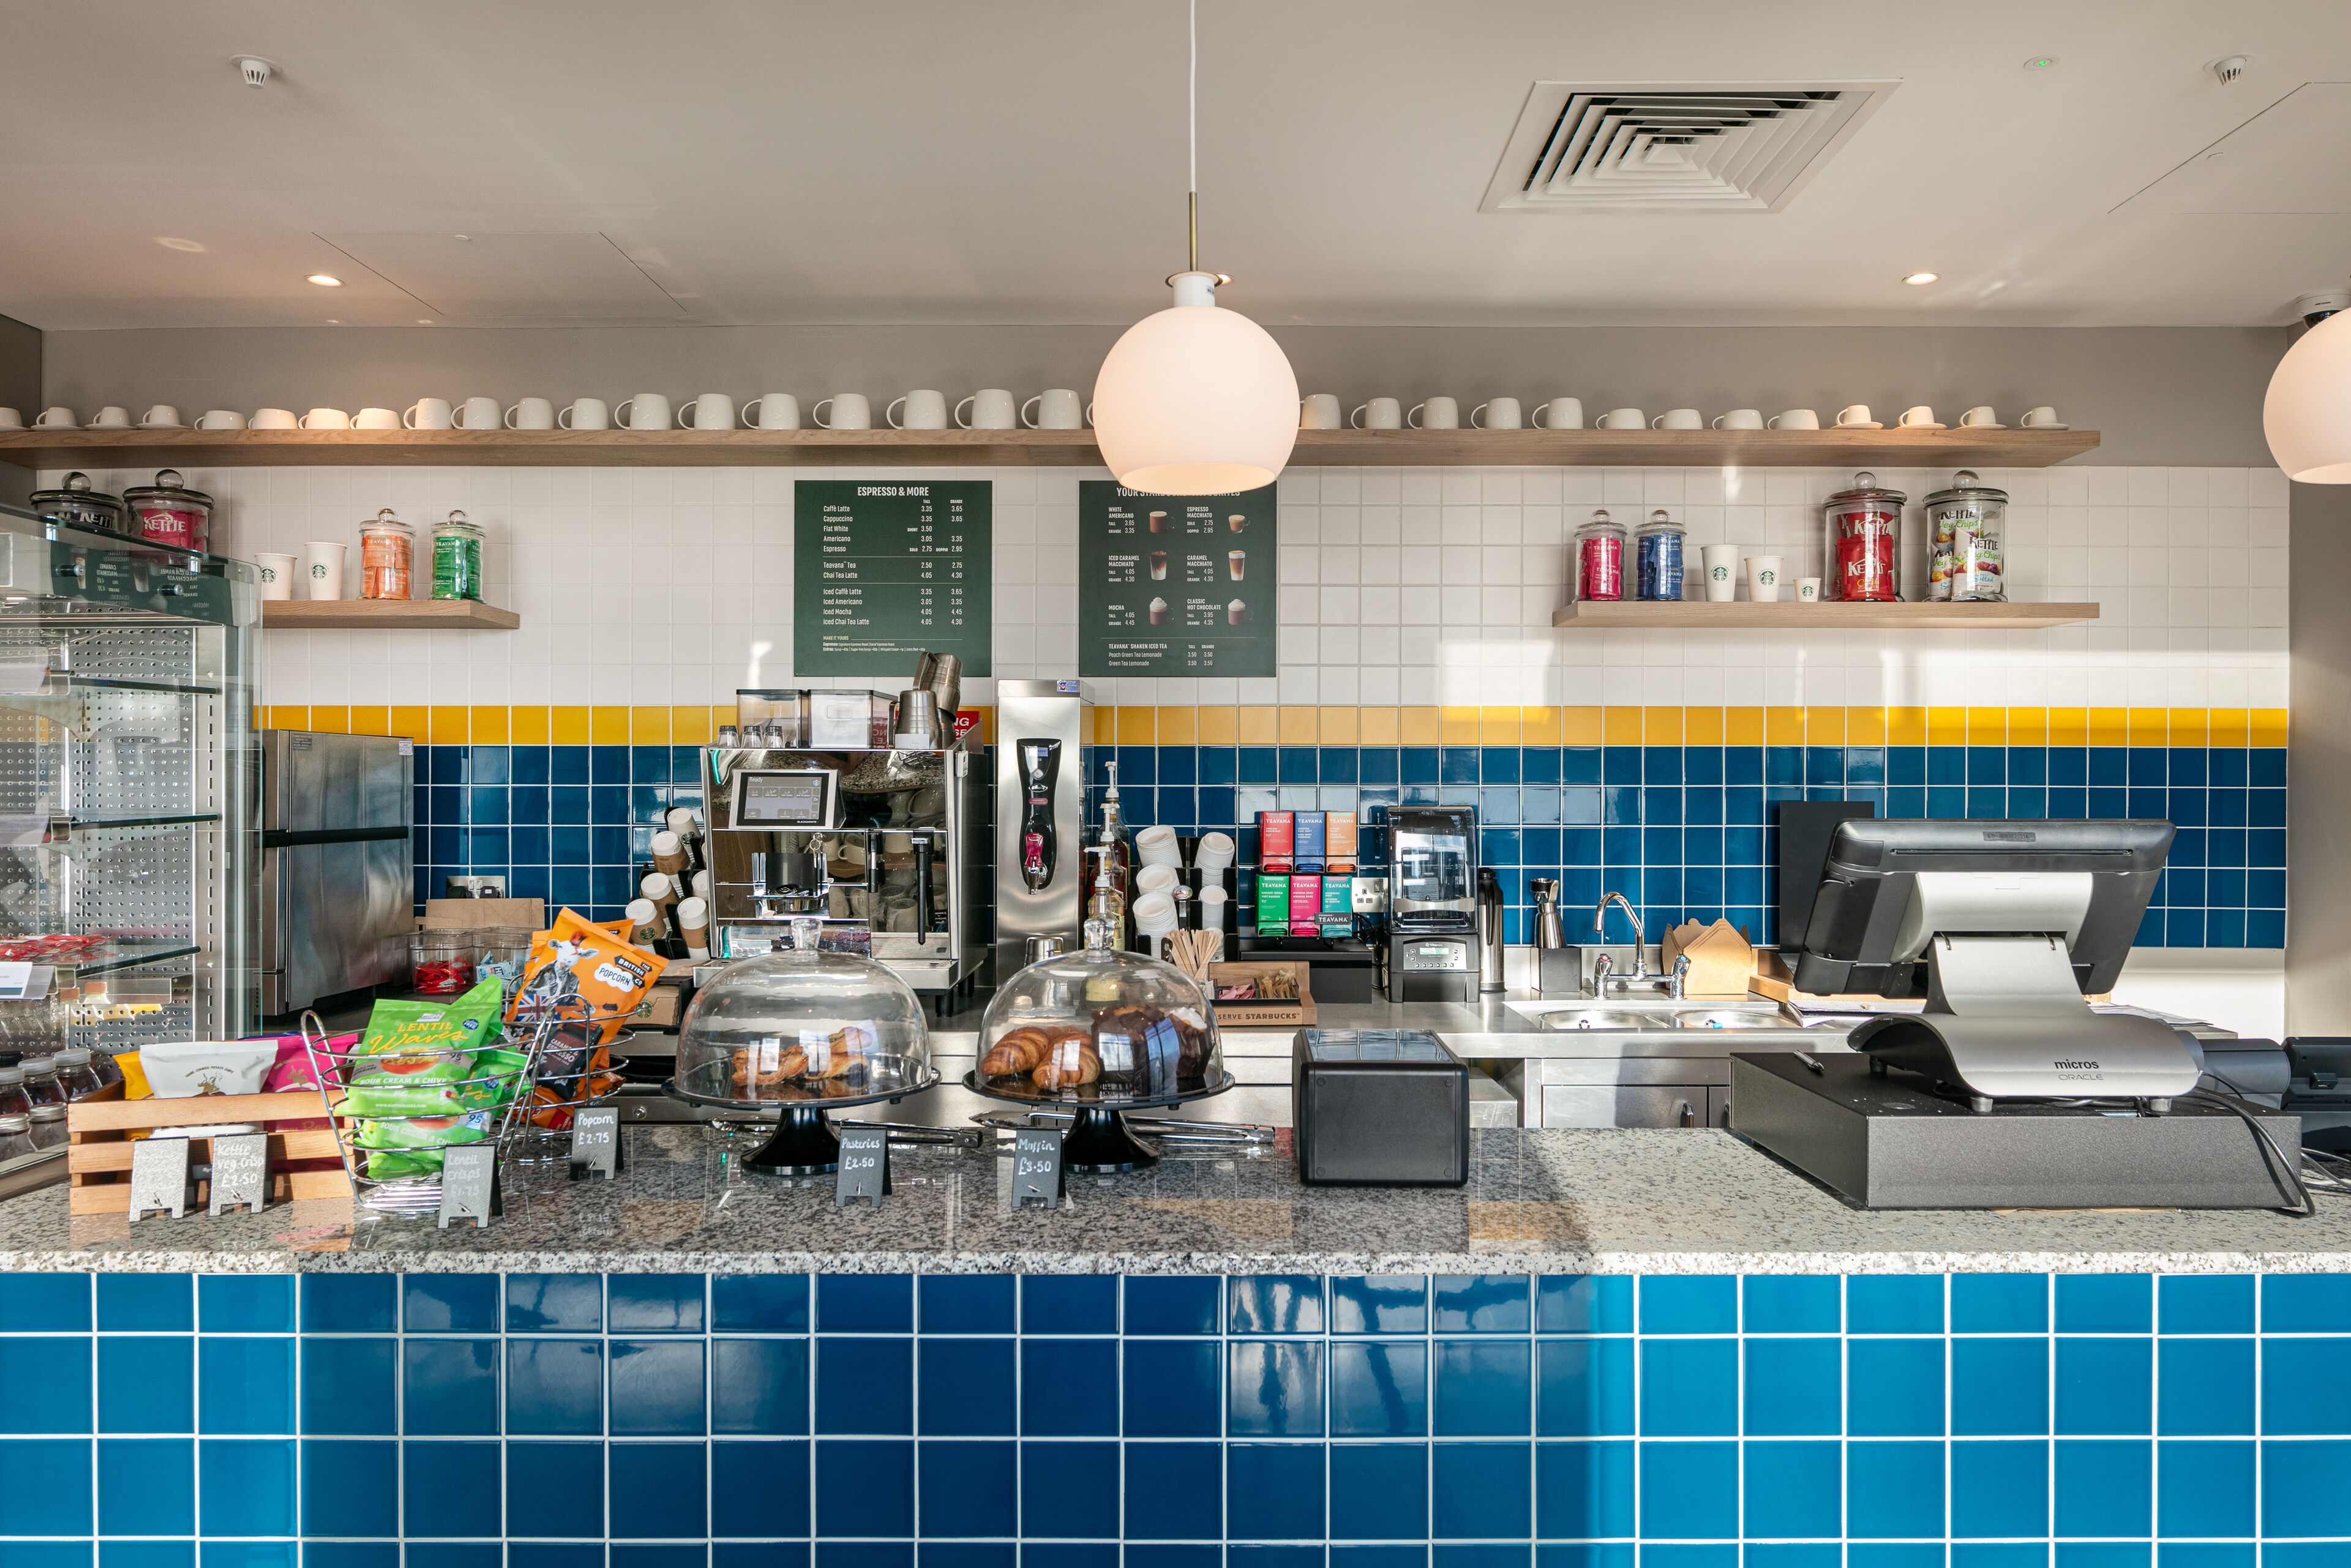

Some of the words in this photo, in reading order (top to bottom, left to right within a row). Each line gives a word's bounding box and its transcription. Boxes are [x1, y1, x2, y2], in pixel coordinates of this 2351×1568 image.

[858, 487, 896, 496] ESPRESSO
[899, 487, 905, 496] &
[907, 487, 929, 496] MORE
[1117, 487, 1138, 497] YOUR
[144, 513, 186, 533] KETTLE
[617, 958, 645, 977] BRITISH
[599, 967, 631, 986] POPCORN
[397, 1022, 453, 1032] LENTIL
[369, 1030, 469, 1054] Waves
[2054, 1059, 2099, 1070] micros
[578, 1112, 615, 1128] Popcorn
[1017, 1138, 1056, 1153] Muffin
[844, 1155, 876, 1170] £2.50
[1018, 1157, 1052, 1176] £3.50
